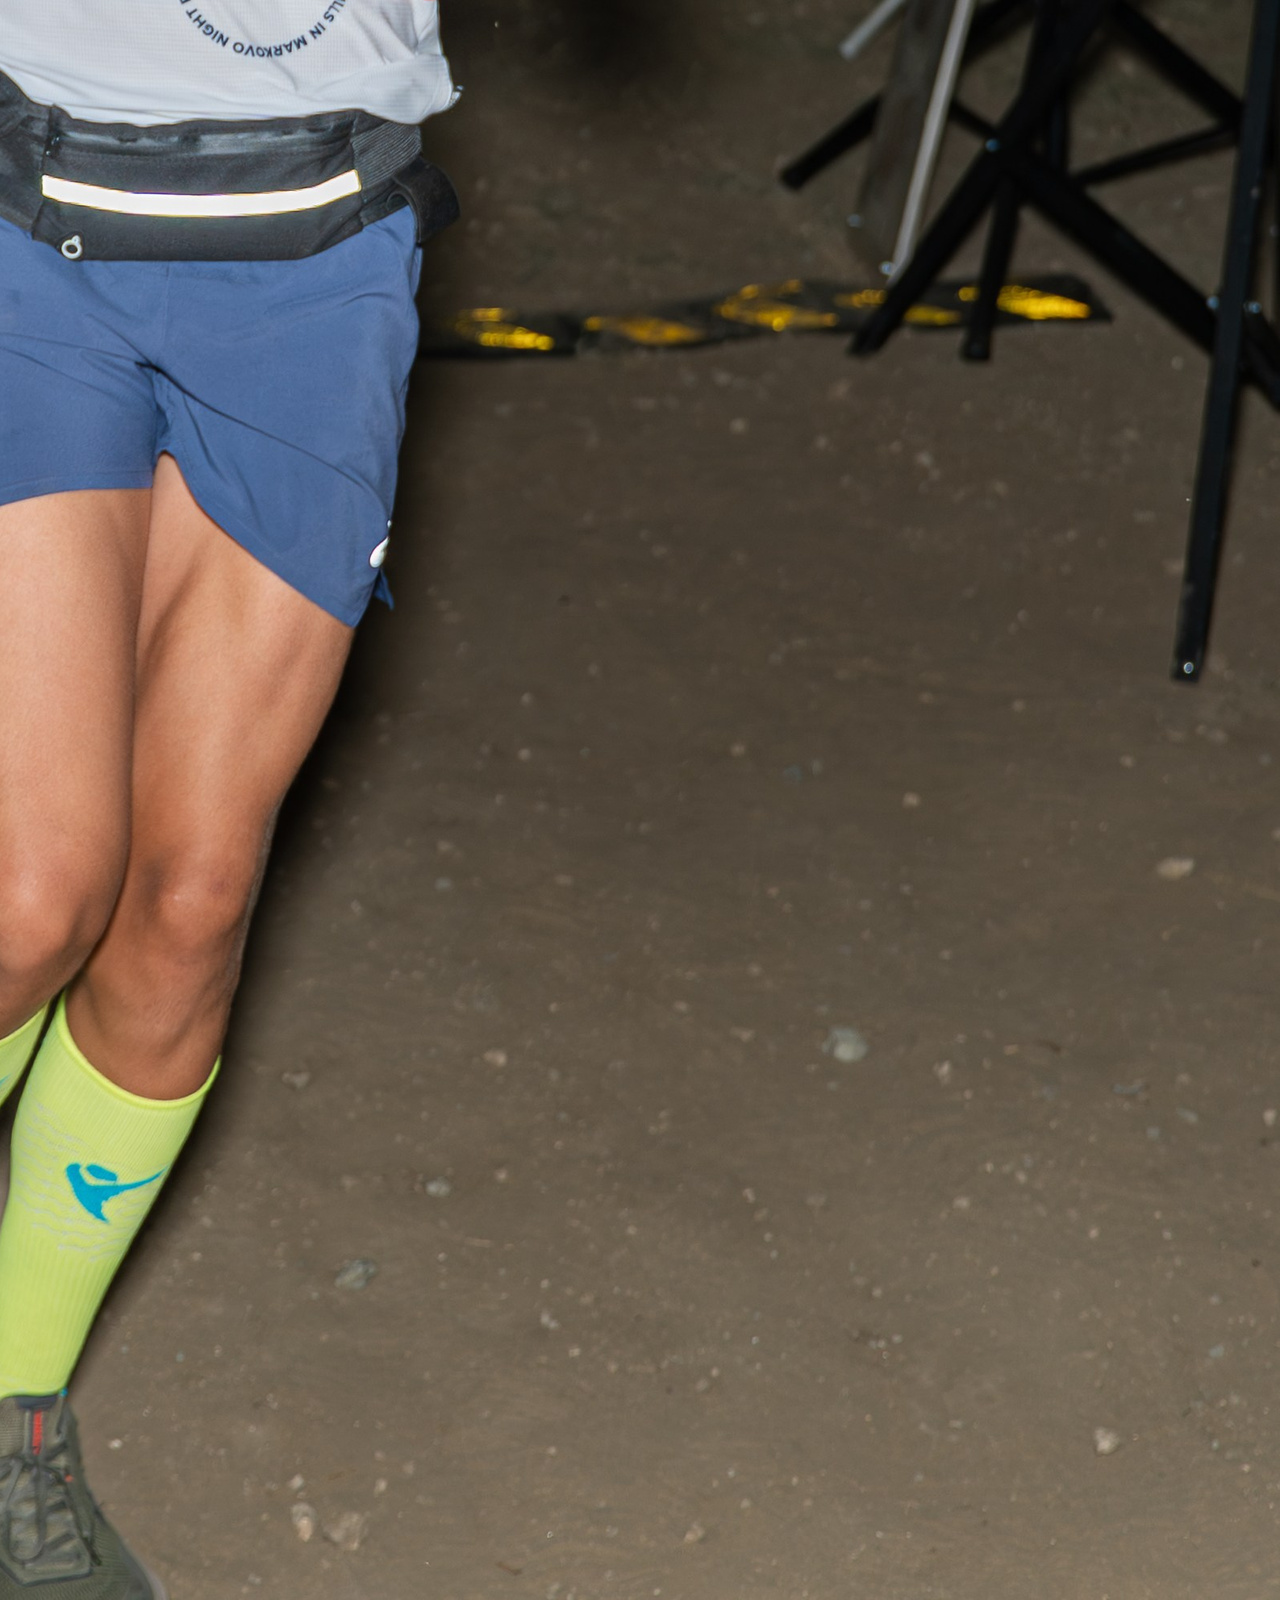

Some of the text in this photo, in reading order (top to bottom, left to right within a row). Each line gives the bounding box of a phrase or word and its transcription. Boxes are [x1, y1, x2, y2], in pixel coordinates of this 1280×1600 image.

[186, 8, 229, 47] NIGHT
[309, 21, 326, 40] IN
[232, 35, 308, 58] MARKOVO
